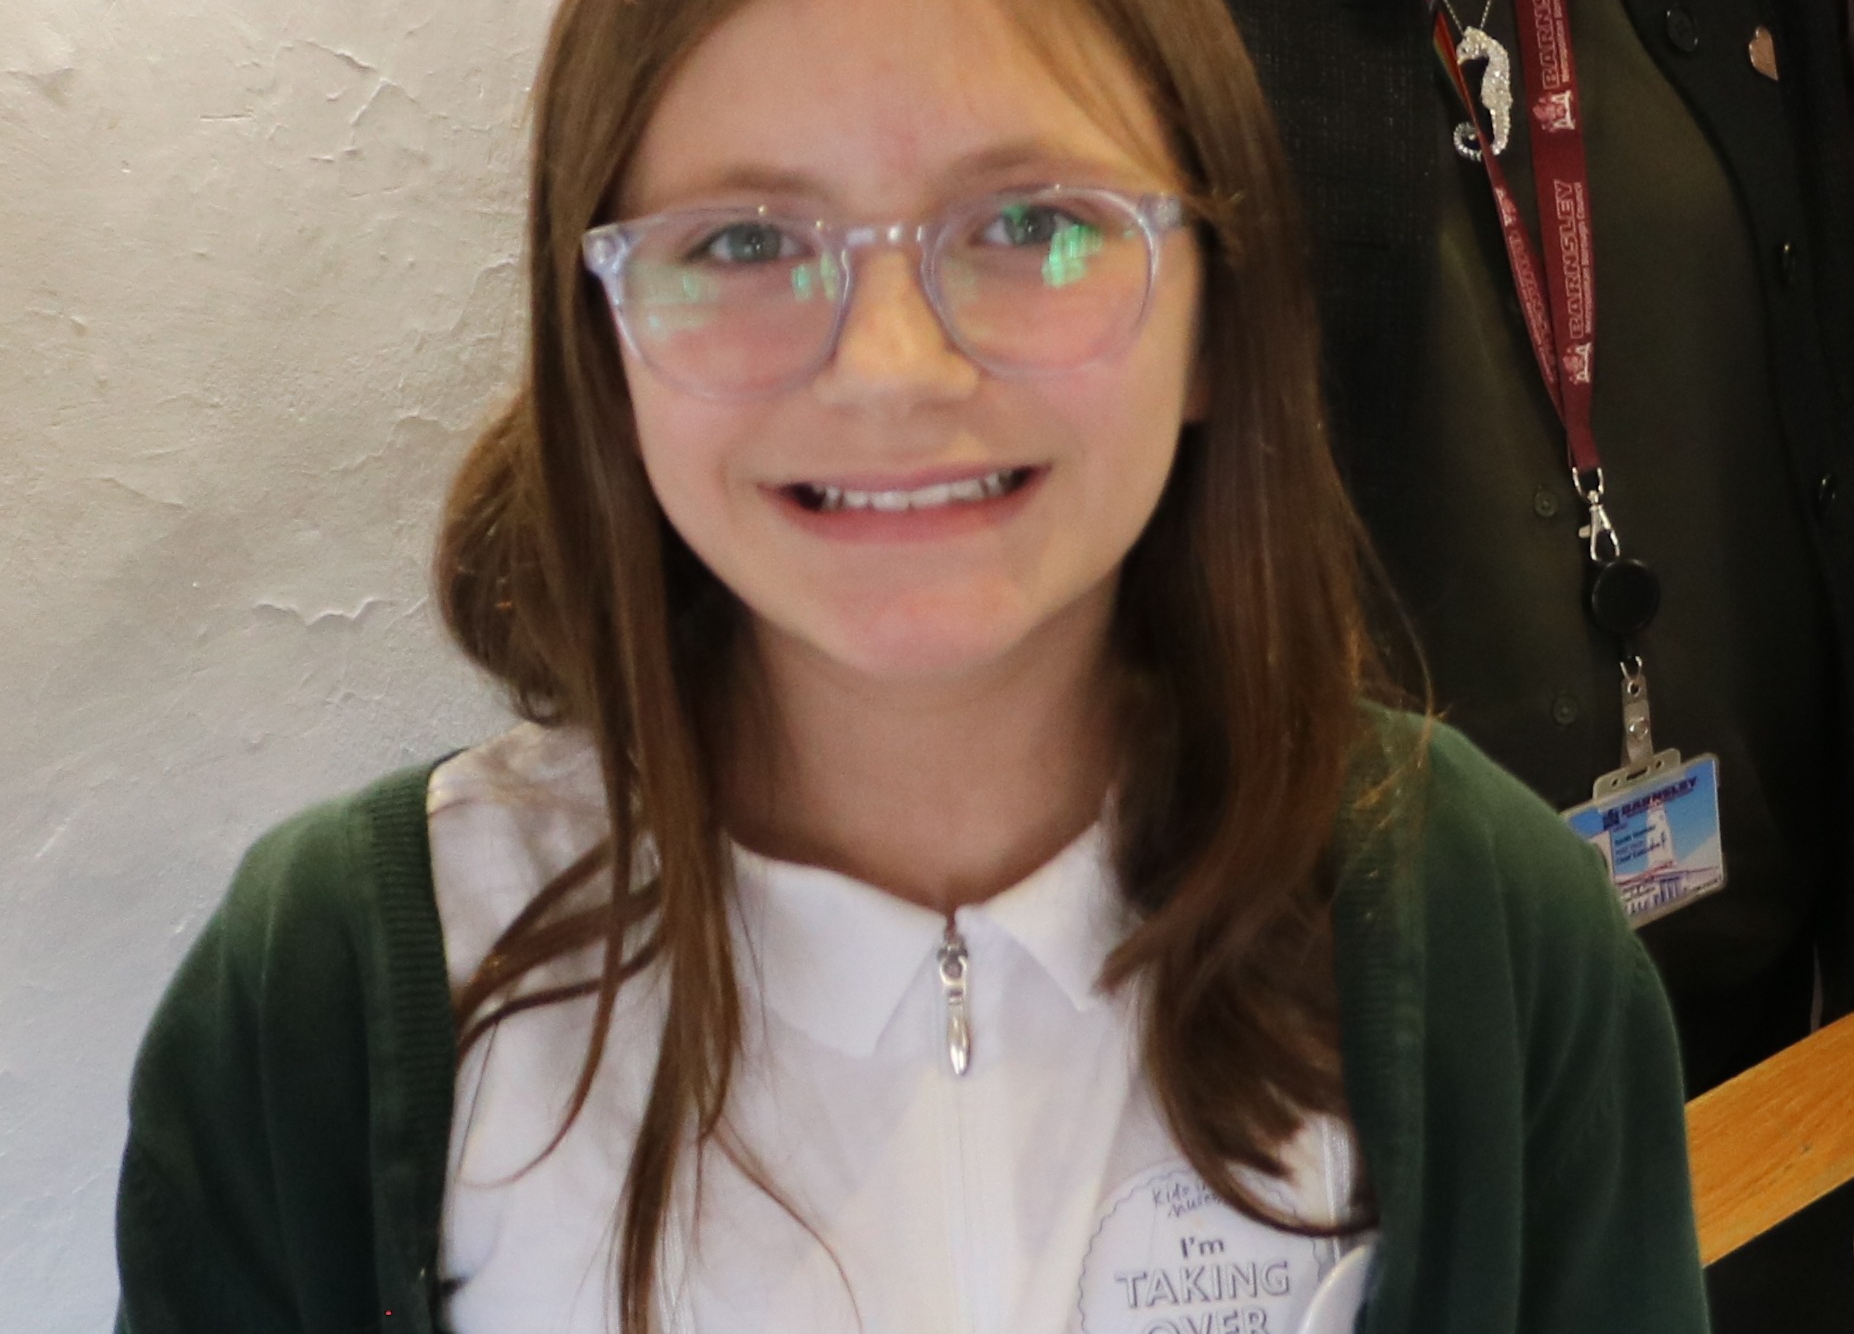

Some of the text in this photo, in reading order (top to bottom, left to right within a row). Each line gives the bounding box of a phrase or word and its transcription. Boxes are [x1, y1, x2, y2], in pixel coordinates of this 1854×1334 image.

[1554, 179, 1584, 339] BARNSLEY
[1181, 1236, 1225, 1259] I'm
[1115, 1259, 1291, 1310] TAKING
